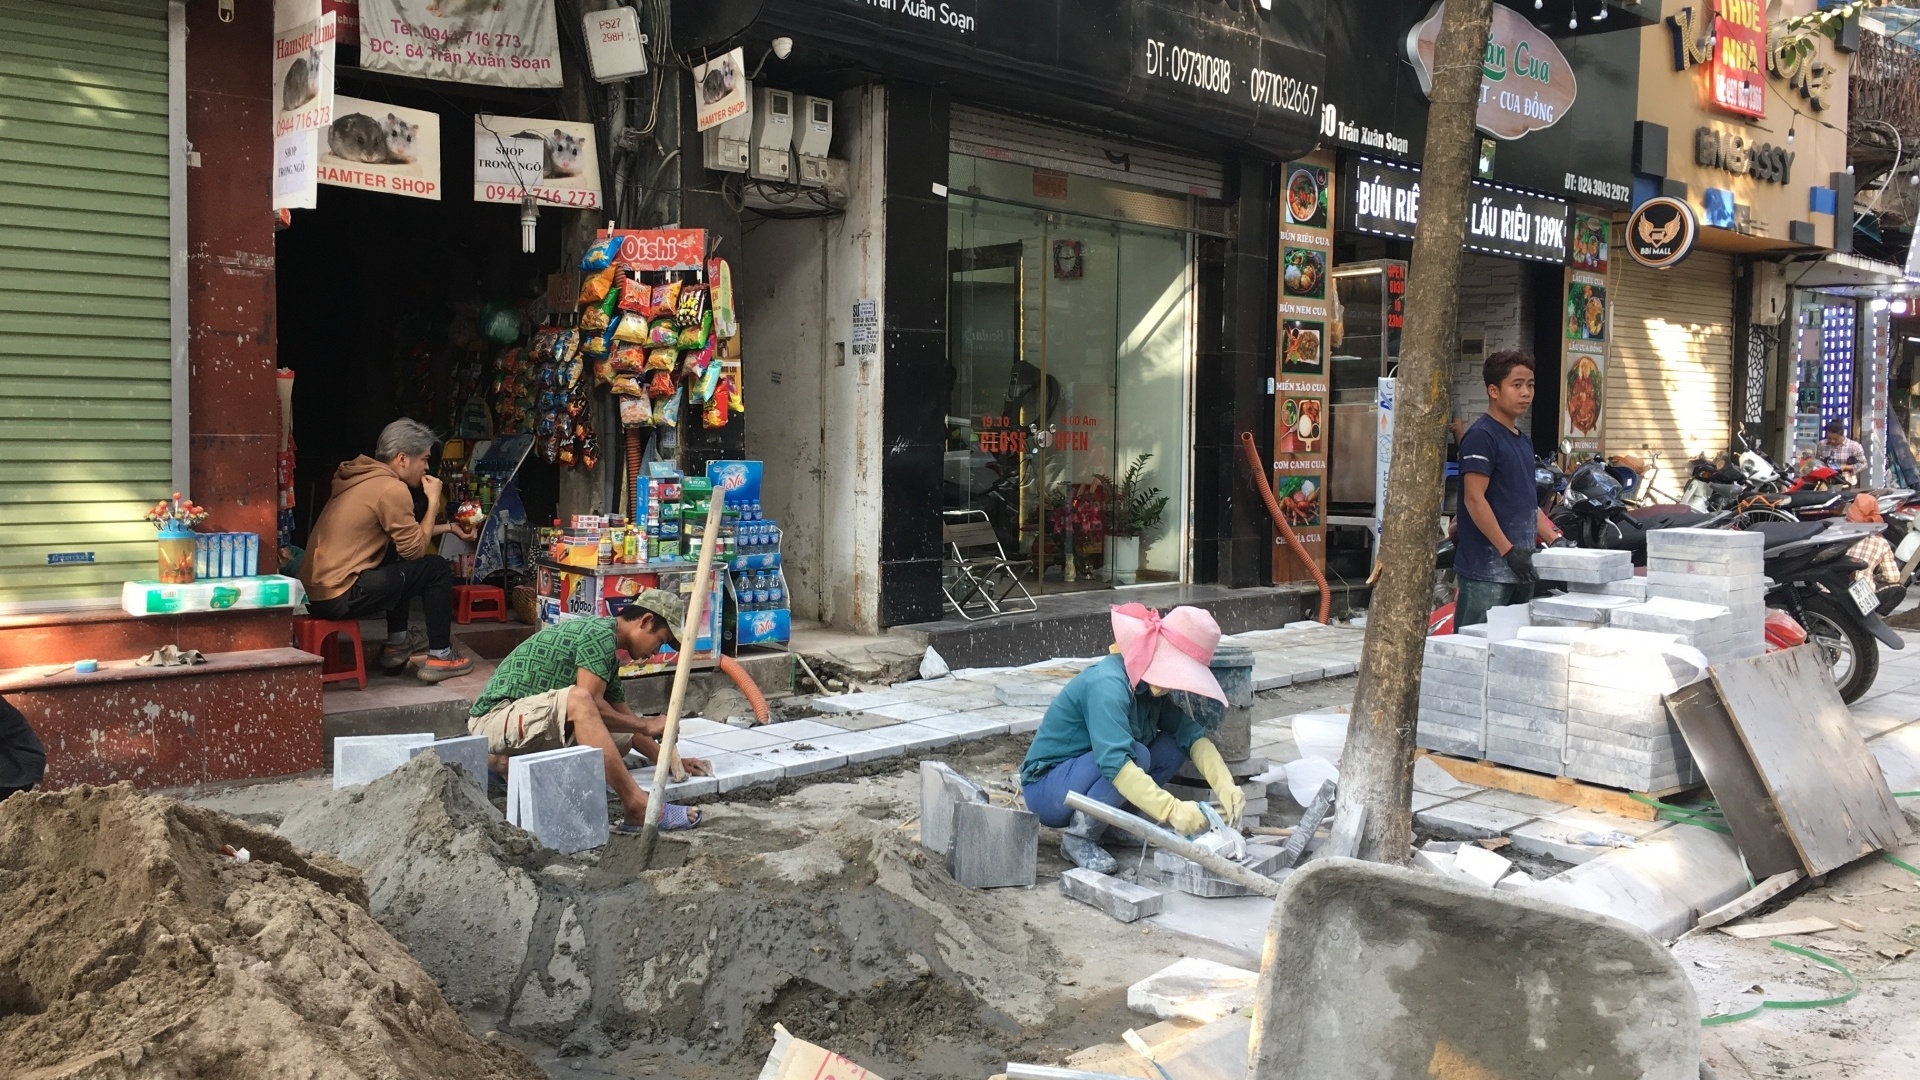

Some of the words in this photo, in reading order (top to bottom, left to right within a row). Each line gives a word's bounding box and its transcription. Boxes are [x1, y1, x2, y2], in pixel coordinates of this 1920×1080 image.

[599, 17, 621, 29] P527
[901, 0, 936, 22] Xuân
[939, 3, 975, 33] Soạn
[276, 32, 313, 59] Hamster
[391, 19, 418, 37] Tel:
[495, 33, 521, 49] 273
[602, 31, 624, 43] 298H
[370, 38, 399, 56] ĐC:
[405, 44, 424, 60] 64
[467, 50, 506, 69] Xuân
[511, 55, 551, 73] Soạn
[1514, 41, 1550, 84] Cua
[1722, 36, 1759, 74] NHÀ
[1171, 45, 1231, 95] 097310818
[1250, 67, 1318, 117] 0971032667
[700, 108, 727, 128] HAMTER
[727, 100, 744, 117] SHOP
[1500, 91, 1520, 114] CUA
[1524, 91, 1554, 123] ĐỒNG
[276, 114, 293, 136] 0944
[296, 111, 312, 128] 716
[313, 106, 330, 125] 273
[495, 145, 524, 156] SHOP
[1338, 120, 1360, 144] Trần
[1360, 126, 1384, 149] Xuân
[1385, 132, 1409, 156] Soạn
[478, 159, 516, 170] TRONG
[1696, 126, 1796, 186] EMBASSY
[317, 166, 386, 189] HAMTER
[391, 177, 436, 195] SHOP
[1577, 176, 1592, 194] 024
[1593, 179, 1611, 199] 3943
[1611, 184, 1629, 202] 2972
[486, 184, 525, 201] 0944
[533, 187, 561, 204] 716
[568, 190, 597, 207] 273
[1359, 175, 1391, 219] BÚN
[1395, 183, 1420, 224] RIÊ
[1500, 203, 1531, 242] RIÊU
[1535, 214, 1564, 248] 189K
[620, 234, 678, 261] Oishi
[1280, 230, 1295, 241] BÚN
[1297, 232, 1314, 244] RIÊU
[1315, 236, 1330, 246] CUA
[1652, 247, 1671, 255] MALL
[1279, 302, 1295, 313] BÚN
[1296, 305, 1312, 315] NEM
[1312, 307, 1327, 317] CUA
[1276, 379, 1295, 391] MIẾN
[1312, 383, 1327, 393] CUA
[1082, 415, 1097, 426] Am
[980, 432, 1027, 453] CLOSE
[1055, 431, 1089, 451] OPEN
[1311, 460, 1326, 469] CUA
[1306, 533, 1322, 543] CUA
